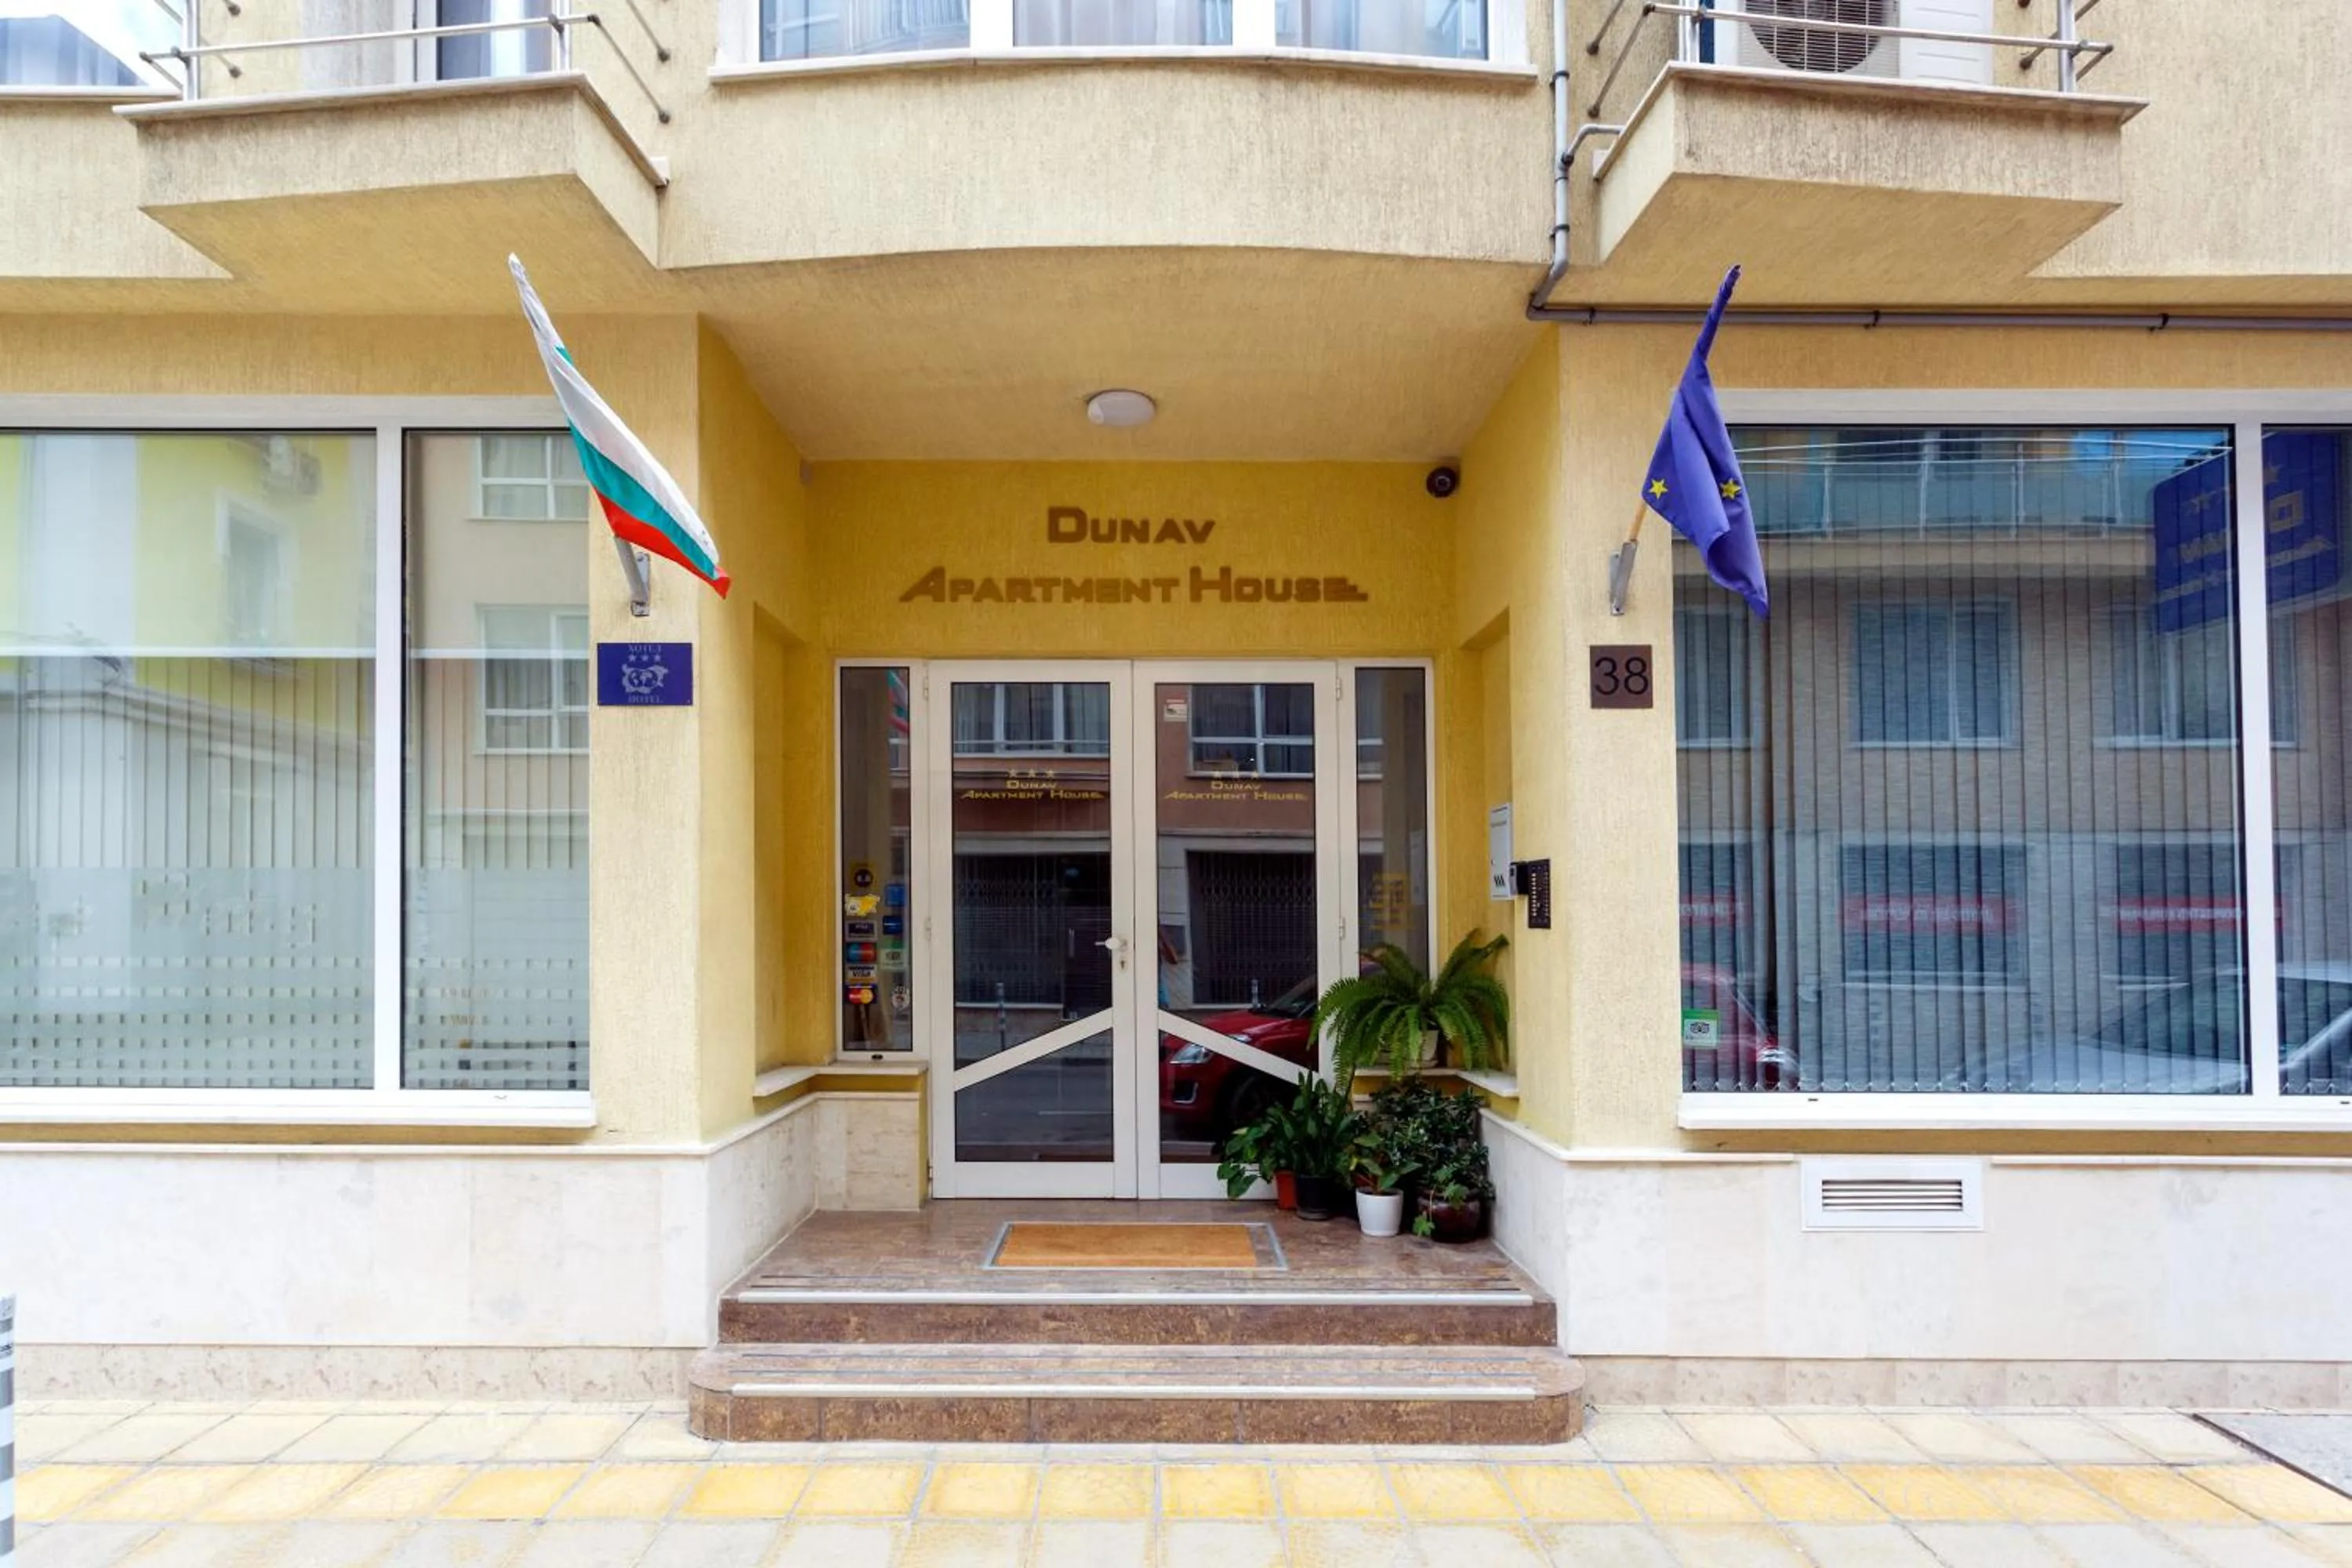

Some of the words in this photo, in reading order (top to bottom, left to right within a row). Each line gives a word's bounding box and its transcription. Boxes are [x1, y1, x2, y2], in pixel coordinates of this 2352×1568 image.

[1047, 506, 1216, 543] DUNAV
[898, 566, 1180, 604] APARTMENT
[1189, 566, 1368, 603] HOUSE
[1595, 656, 1649, 695] 38
[1006, 779, 1058, 789] DUNAV
[1210, 781, 1261, 790] DUNAV
[960, 789, 1044, 800] APARTMENT
[1050, 789, 1105, 800] HOUSE
[1163, 791, 1247, 800] APARTMENT
[1254, 792, 1308, 801] HOUSE
